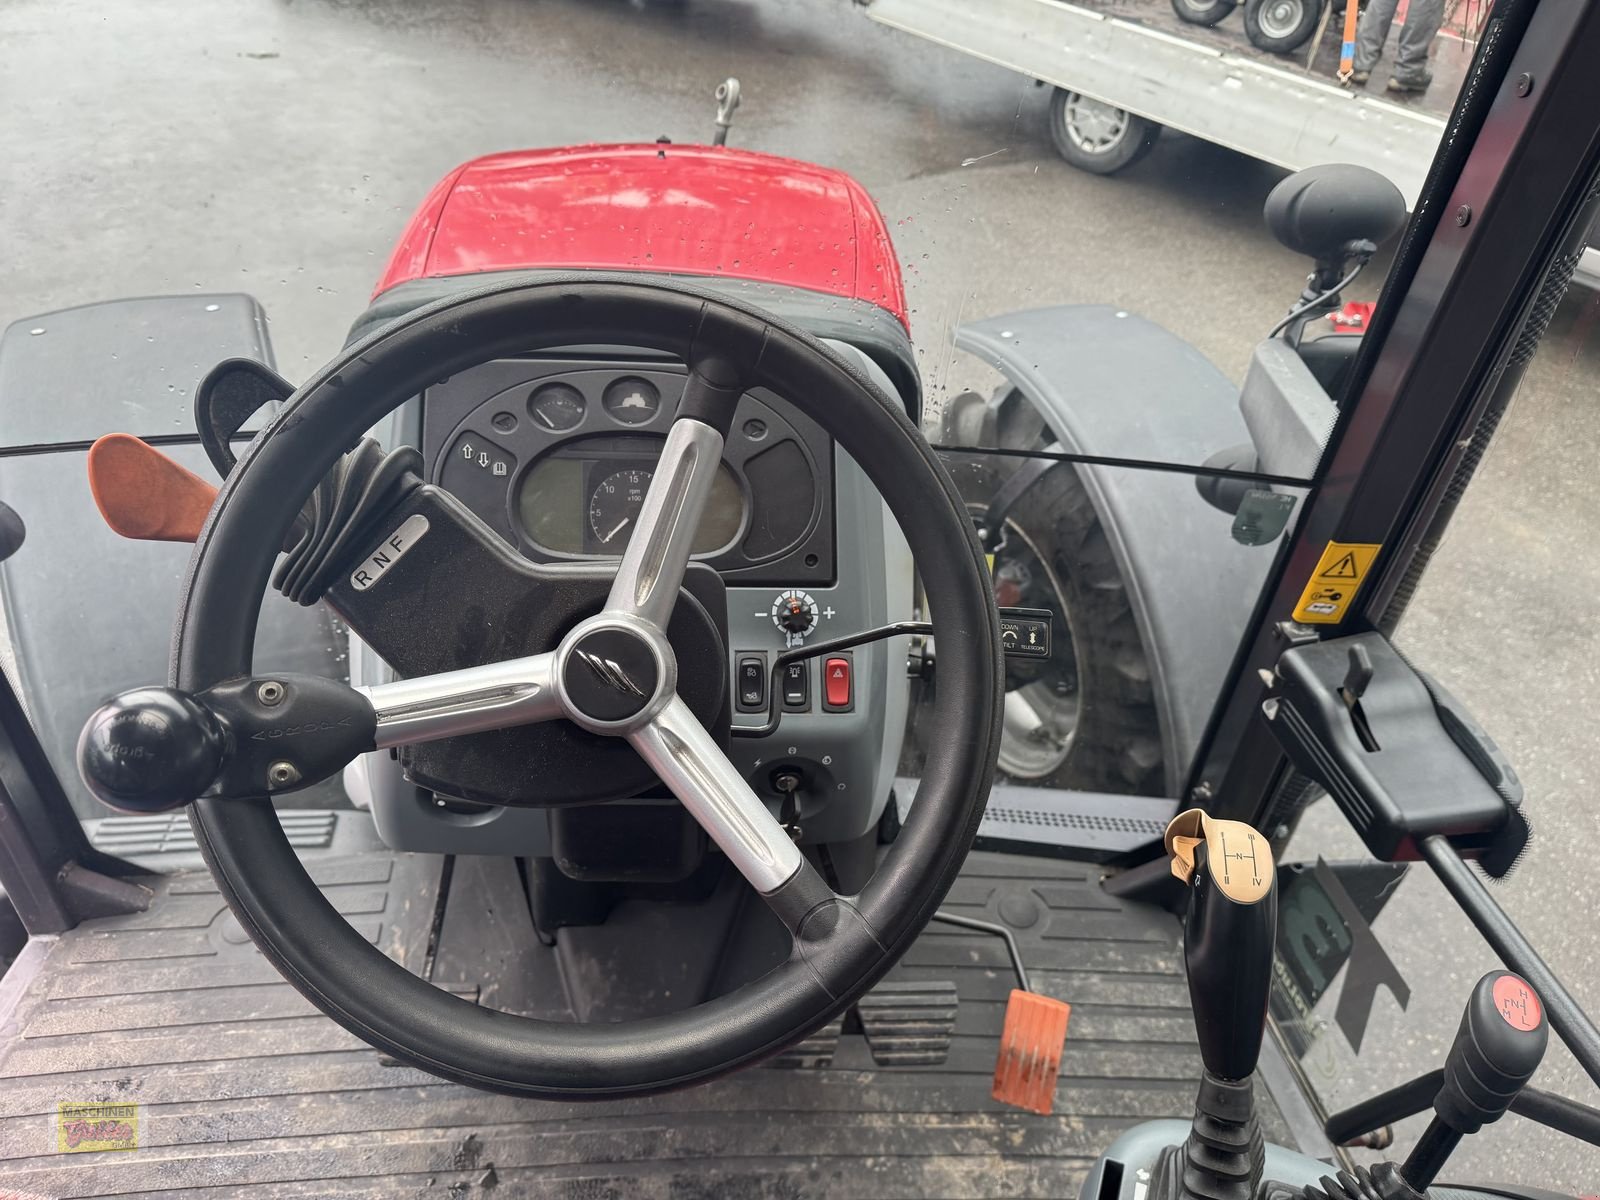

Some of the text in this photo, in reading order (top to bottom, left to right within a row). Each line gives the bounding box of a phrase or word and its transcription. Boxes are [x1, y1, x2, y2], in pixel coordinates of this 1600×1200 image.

[629, 475, 639, 483] 15
[595, 509, 602, 517] 5
[1001, 623, 1019, 631] DOWN
[1236, 852, 1243, 860] N
[1252, 878, 1262, 886] IV
[1520, 989, 1528, 999] H
[1511, 998, 1519, 1009] N
